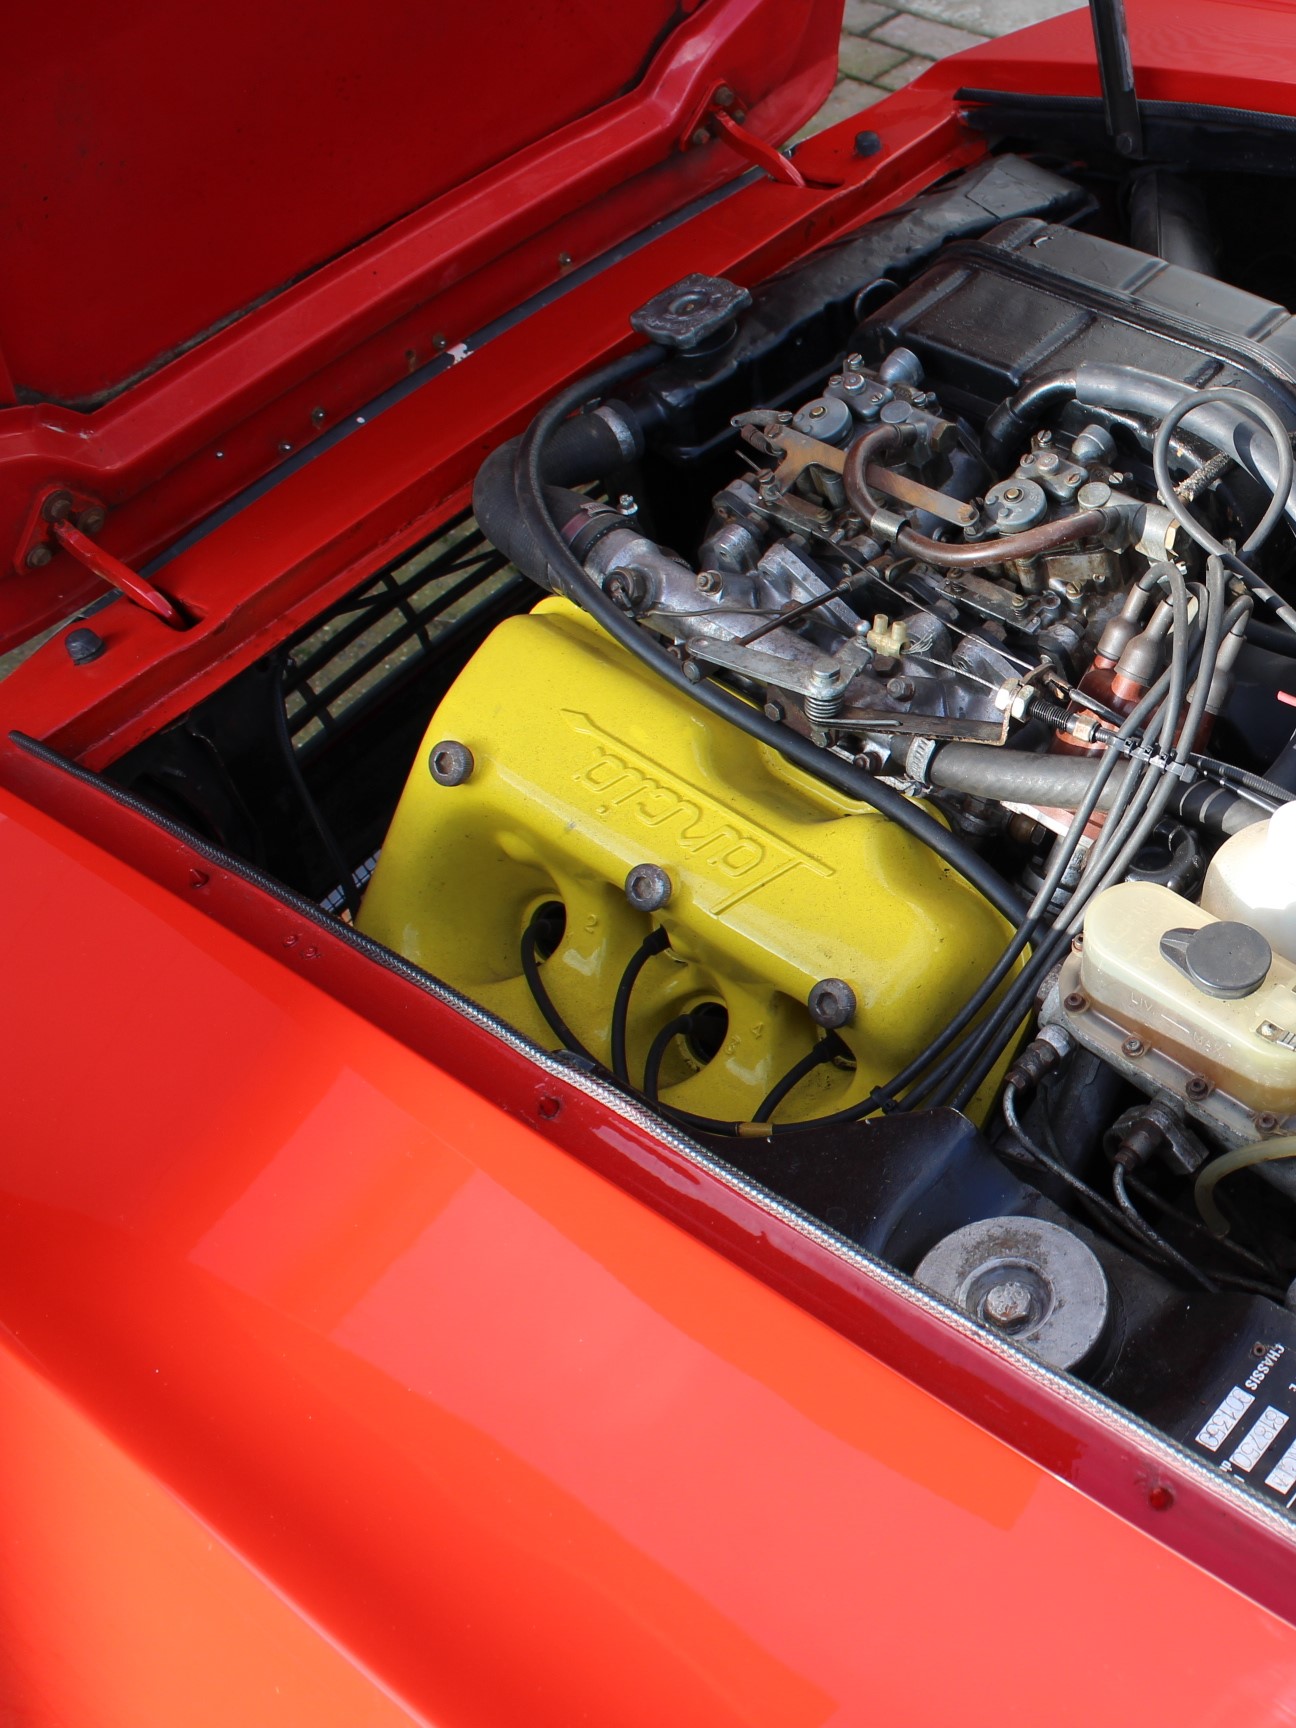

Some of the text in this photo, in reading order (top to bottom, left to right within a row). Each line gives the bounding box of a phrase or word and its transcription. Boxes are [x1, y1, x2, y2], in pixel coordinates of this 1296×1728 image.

[562, 712, 836, 916] Lancia
[1244, 1343, 1285, 1392] CHASSIS
[1230, 1407, 1287, 1471] 818750
